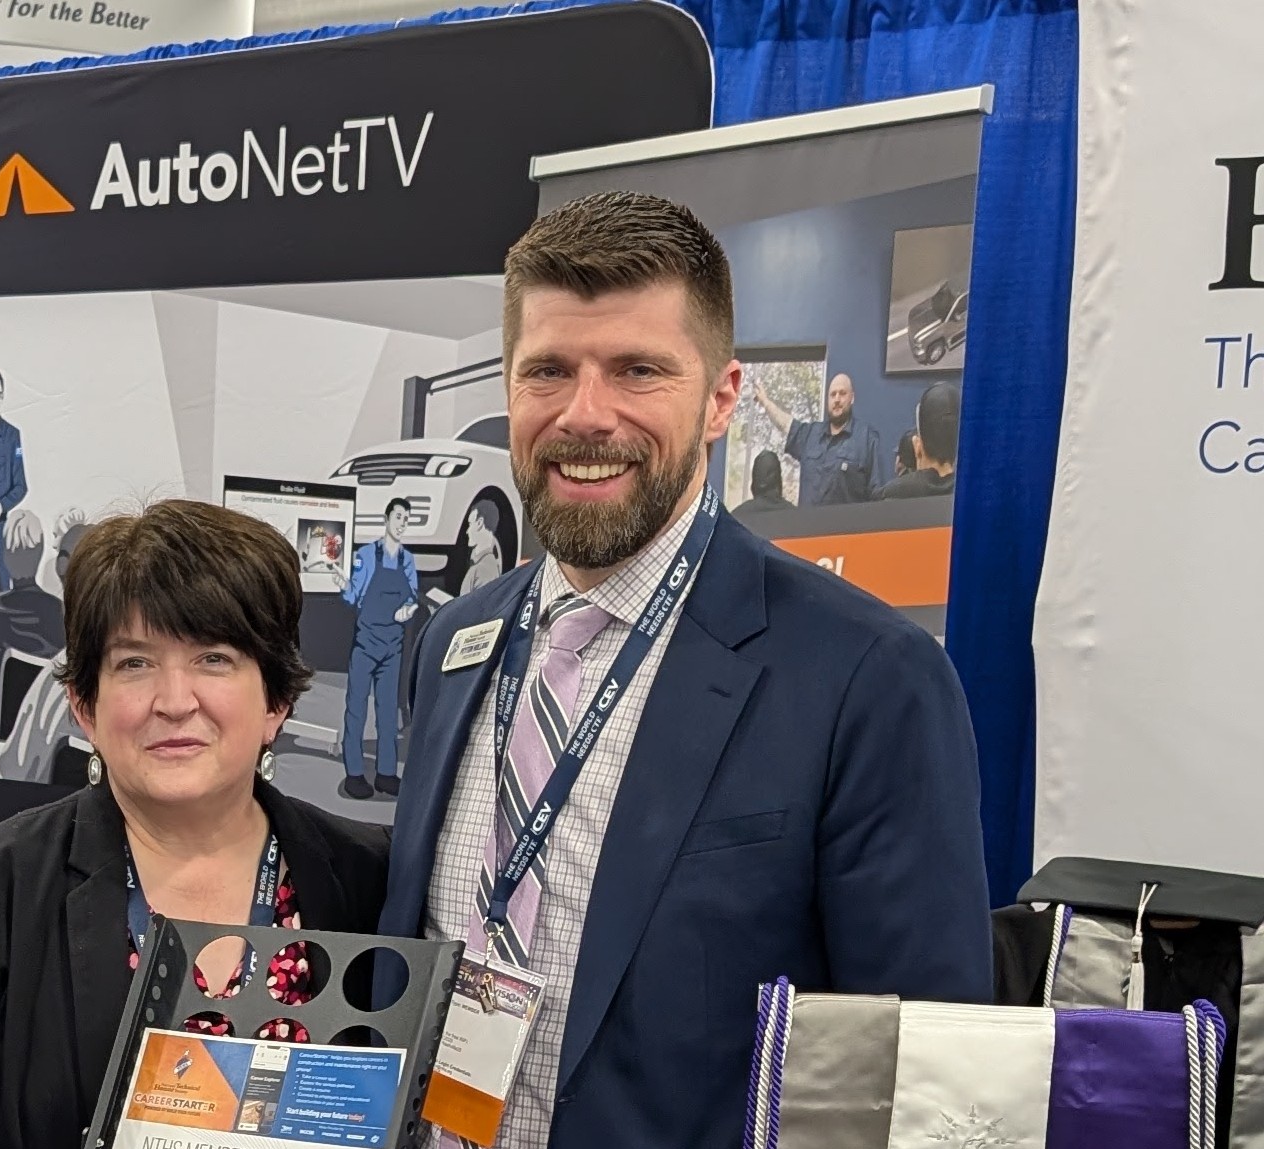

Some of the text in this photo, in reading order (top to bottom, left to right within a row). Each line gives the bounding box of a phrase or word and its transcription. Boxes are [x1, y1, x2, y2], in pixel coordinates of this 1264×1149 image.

[50, 5, 83, 22] the
[90, 7, 150, 31] Better
[90, 111, 434, 211] AutoNetTV
[638, 589, 667, 632] THE WORLD
[646, 594, 674, 638] NEEDS CTE
[568, 711, 596, 755] THE WORLD
[576, 716, 603, 759] NEEDS CTE
